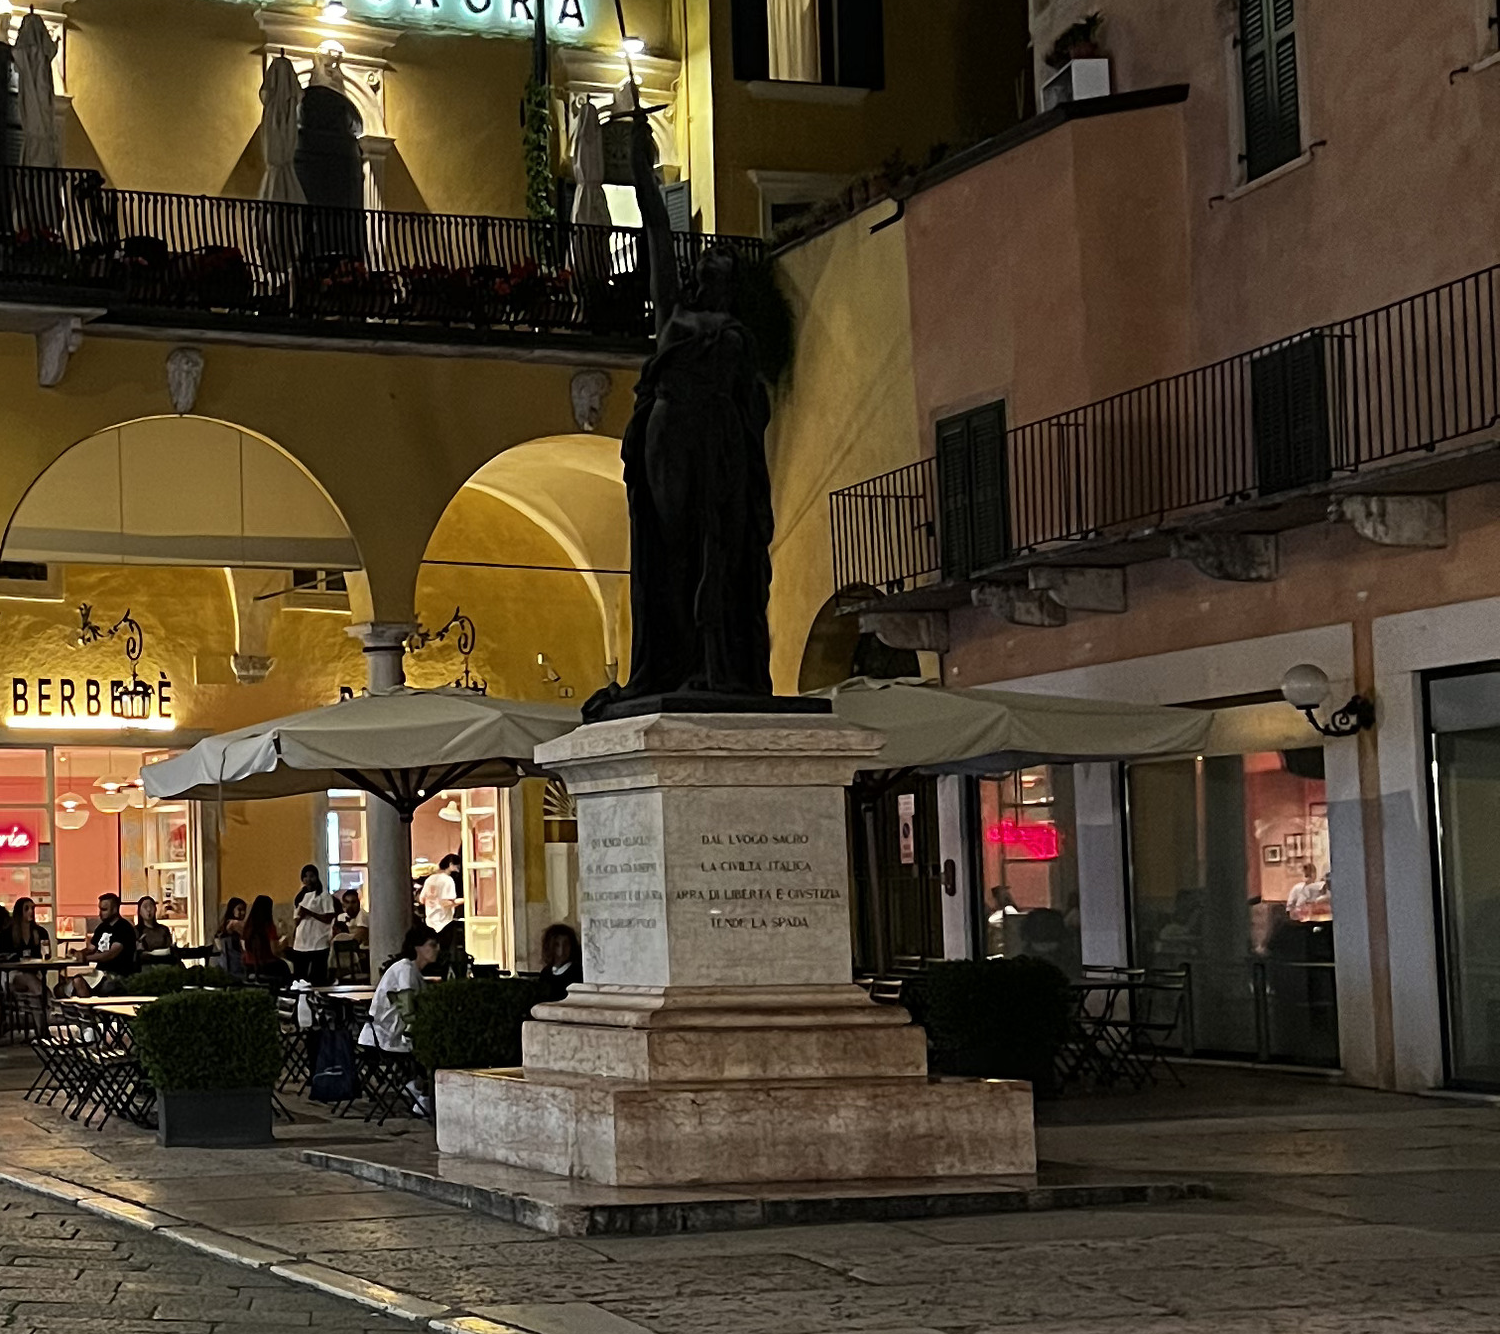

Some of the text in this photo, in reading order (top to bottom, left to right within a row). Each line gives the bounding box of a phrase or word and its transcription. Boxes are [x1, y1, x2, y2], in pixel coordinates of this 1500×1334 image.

[701, 834, 724, 845] DAL
[772, 834, 809, 844] SACRO
[701, 861, 717, 872] LA
[708, 889, 720, 900] DI
[751, 917, 767, 928] LA
